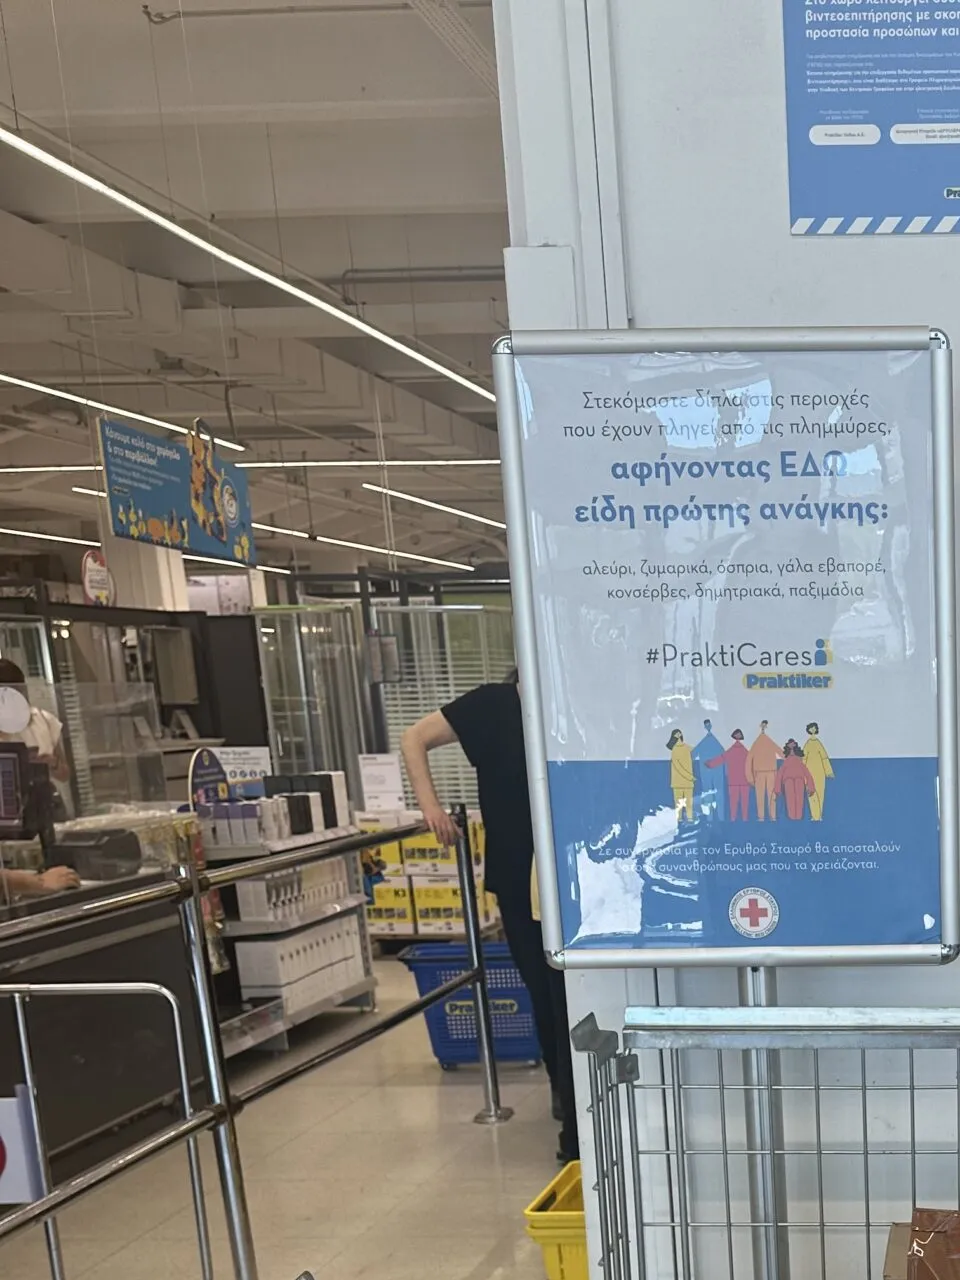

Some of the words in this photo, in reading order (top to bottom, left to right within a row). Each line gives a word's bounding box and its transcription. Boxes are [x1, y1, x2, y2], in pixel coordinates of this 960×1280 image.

[805, 9, 912, 24] βιντεοεπιτήρησης
[916, 11, 930, 23] με
[806, 26, 869, 40] προστασία
[873, 25, 938, 39] προσώπων
[942, 27, 959, 37] και
[582, 391, 689, 412] Στεκόμαστε
[696, 388, 745, 409] δίπλα
[750, 391, 784, 409] στις
[791, 388, 870, 410] περιοχές
[563, 423, 596, 438] που
[601, 418, 652, 441] έχουν
[659, 416, 717, 440] πληγεί
[721, 420, 755, 440] από
[763, 420, 784, 438] τις
[790, 416, 892, 438] πλημμύρες,
[611, 453, 771, 486] αφήνοντας
[780, 450, 847, 478] ΕΔΩ
[574, 494, 636, 529] είδη
[643, 495, 750, 529] πρώτης
[759, 494, 889, 527] ανάγκης:
[582, 559, 636, 579] αλεύρι,
[640, 559, 713, 579] ζυμαρικά,
[717, 560, 773, 578] όσπρια,
[777, 558, 814, 576] γάλα
[818, 556, 887, 576] εβαπορέ,
[607, 583, 690, 603] κονσέρβες,
[695, 583, 785, 602] δημητριακά,
[789, 581, 865, 599] παξιμάδια
[646, 641, 814, 669] #PraktiCares
[746, 673, 832, 689] Praktiker
[598, 844, 611, 856] Σε
[615, 843, 682, 858] συνργσία
[685, 845, 699, 859] με
[702, 846, 721, 856] τον
[724, 842, 767, 857] Ερυθρό
[770, 842, 812, 856] Σταυρό
[815, 841, 830, 854] θα
[832, 840, 901, 854] αποσταλούν
[659, 859, 743, 873] συνανθρώπους
[746, 861, 768, 873] μας
[771, 861, 791, 871] που
[794, 861, 808, 871] τα
[811, 857, 880, 873] χρειάζονται.
[448, 1001, 517, 1014] Praker
